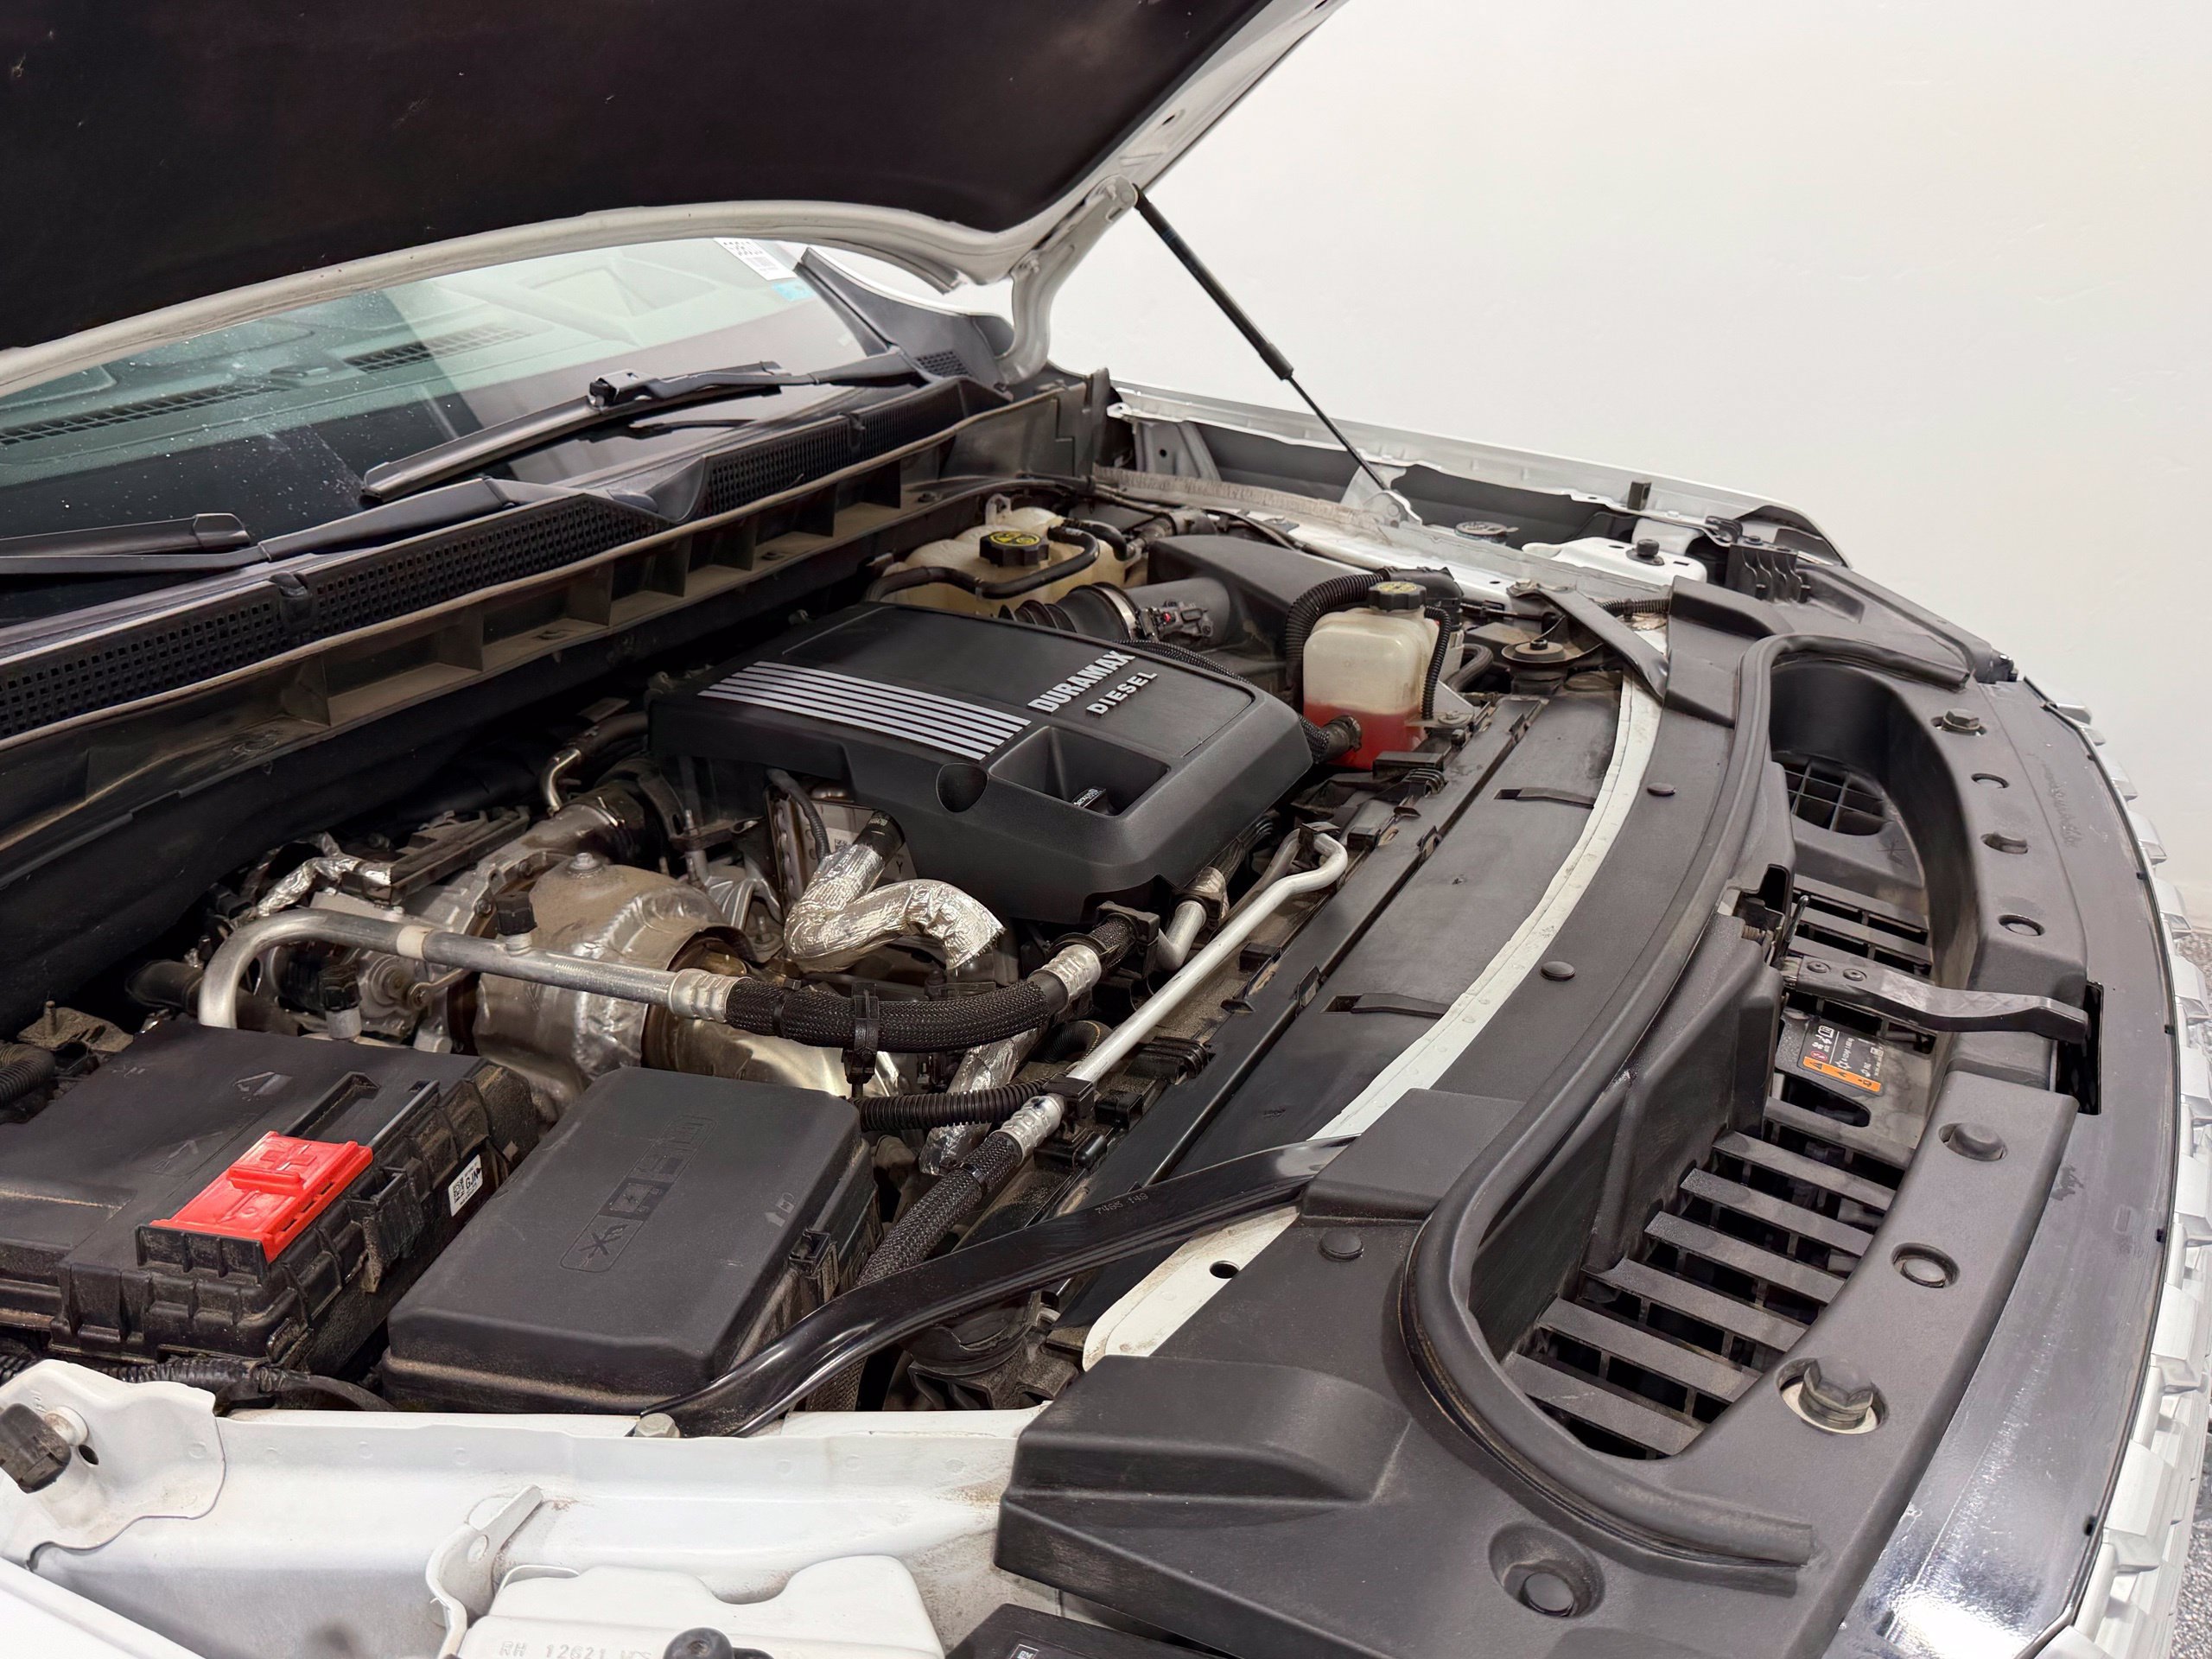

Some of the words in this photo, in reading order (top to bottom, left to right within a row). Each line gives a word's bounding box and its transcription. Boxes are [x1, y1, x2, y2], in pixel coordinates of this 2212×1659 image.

[1027, 650, 1135, 714] DURAMAX
[1085, 671, 1159, 715] DIESEL
[499, 1641, 527, 1657] RH
